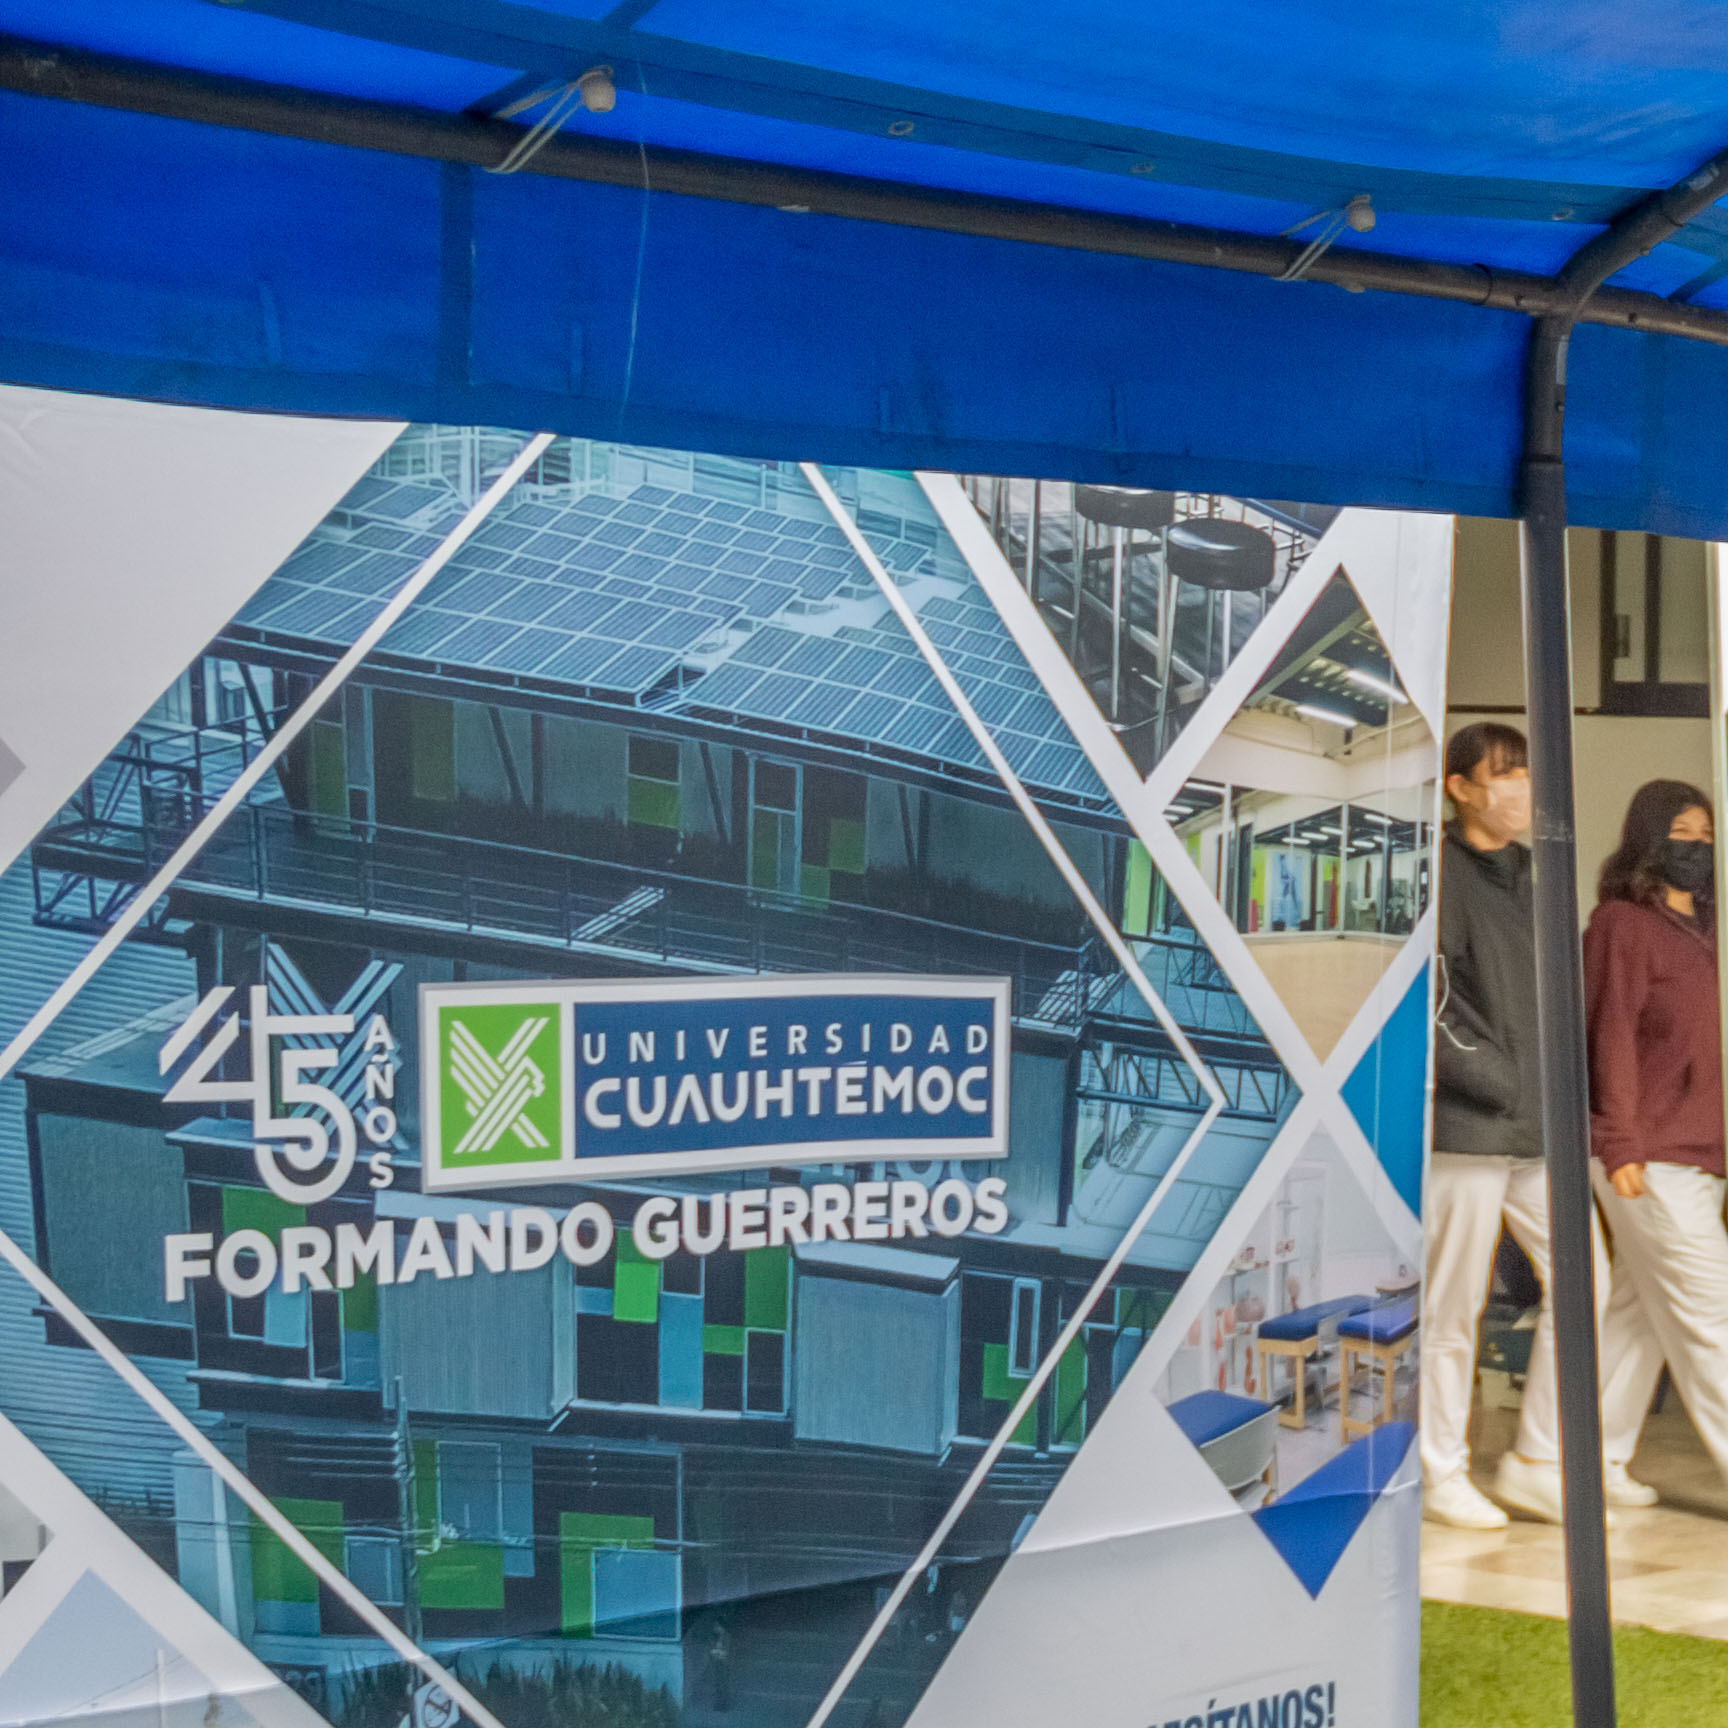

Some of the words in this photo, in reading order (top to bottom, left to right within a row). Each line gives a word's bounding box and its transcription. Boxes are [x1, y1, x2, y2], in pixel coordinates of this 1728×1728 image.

[159, 985, 357, 1205] 45
[363, 1013, 399, 1189] AÑOS
[582, 1023, 989, 1067] UNIVERSIDAD
[164, 1202, 614, 1303] FORMANDO
[633, 1177, 1009, 1260] GUERREROS
